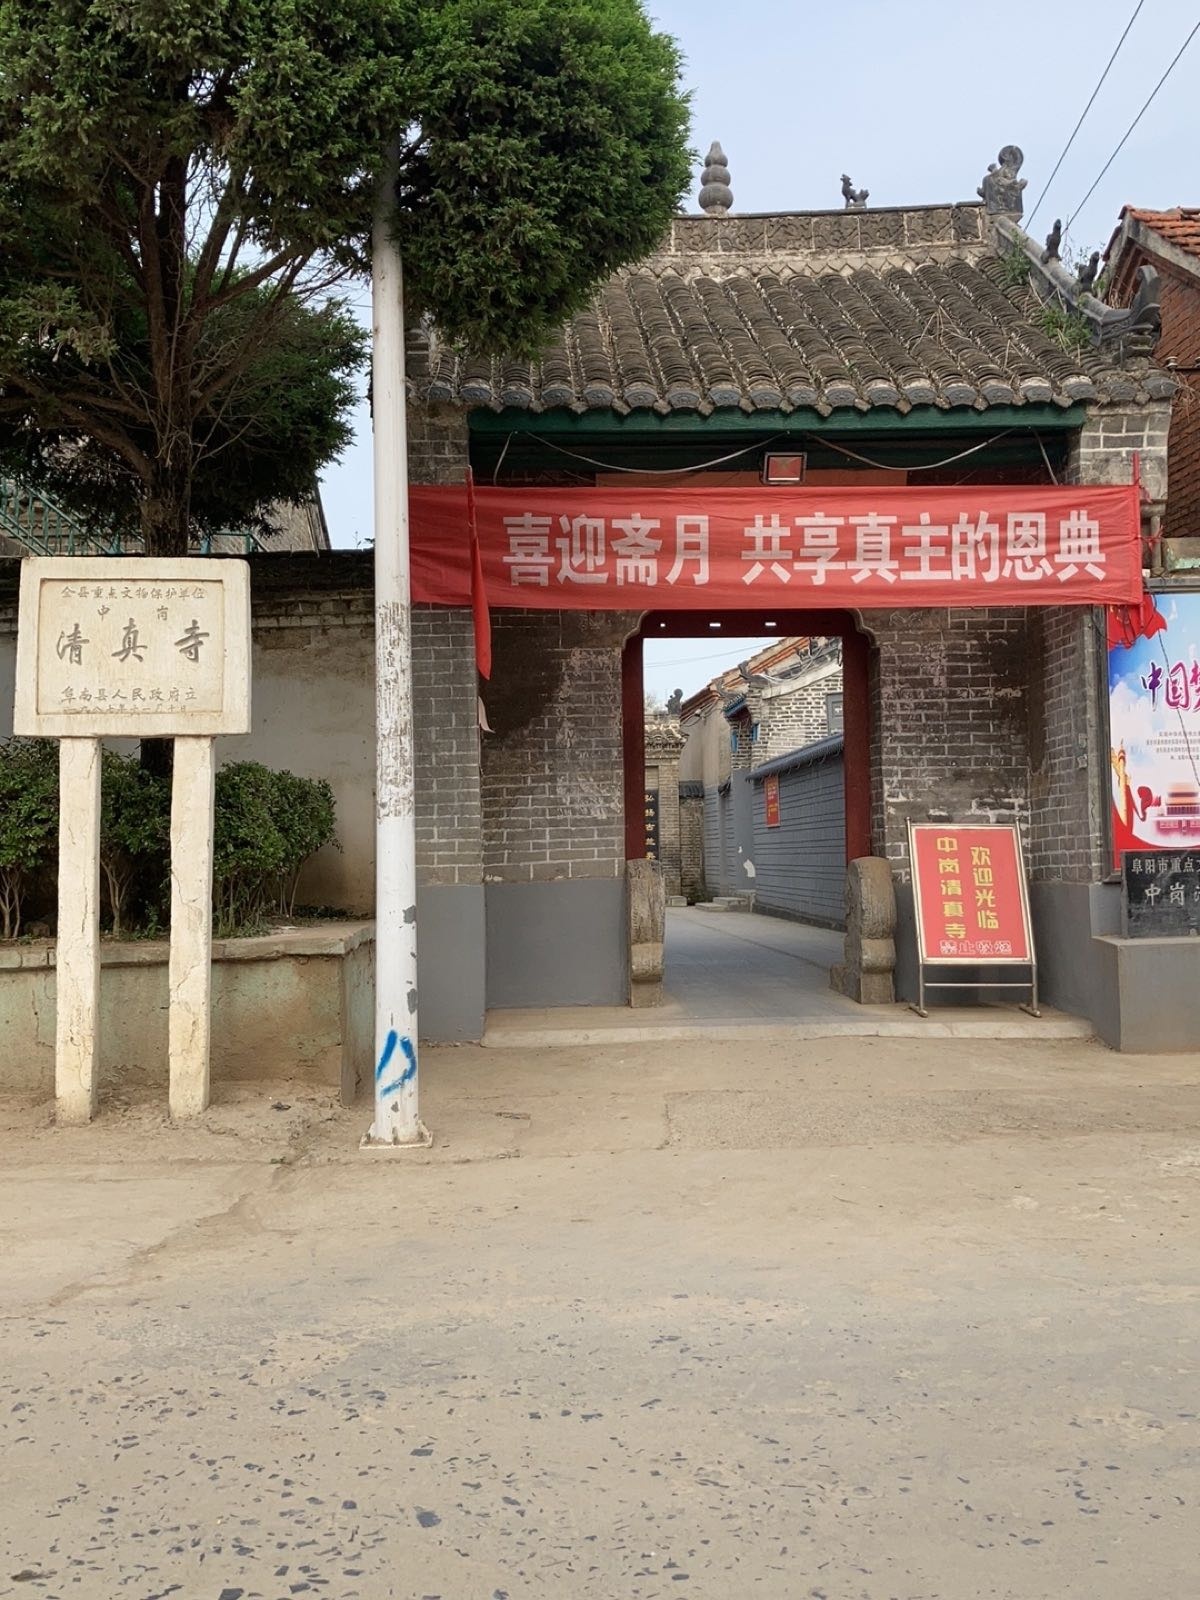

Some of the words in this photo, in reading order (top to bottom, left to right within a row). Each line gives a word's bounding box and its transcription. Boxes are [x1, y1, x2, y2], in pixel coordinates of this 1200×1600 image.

[503, 512, 710, 587] 喜迎斋月
[740, 510, 1107, 586] 共享真主的恩典
[56, 617, 210, 666] 清真寺
[60, 685, 198, 704] 阜南县人民政府立
[936, 836, 967, 939] 中岗清真寺
[970, 846, 999, 929] 欢迎光临
